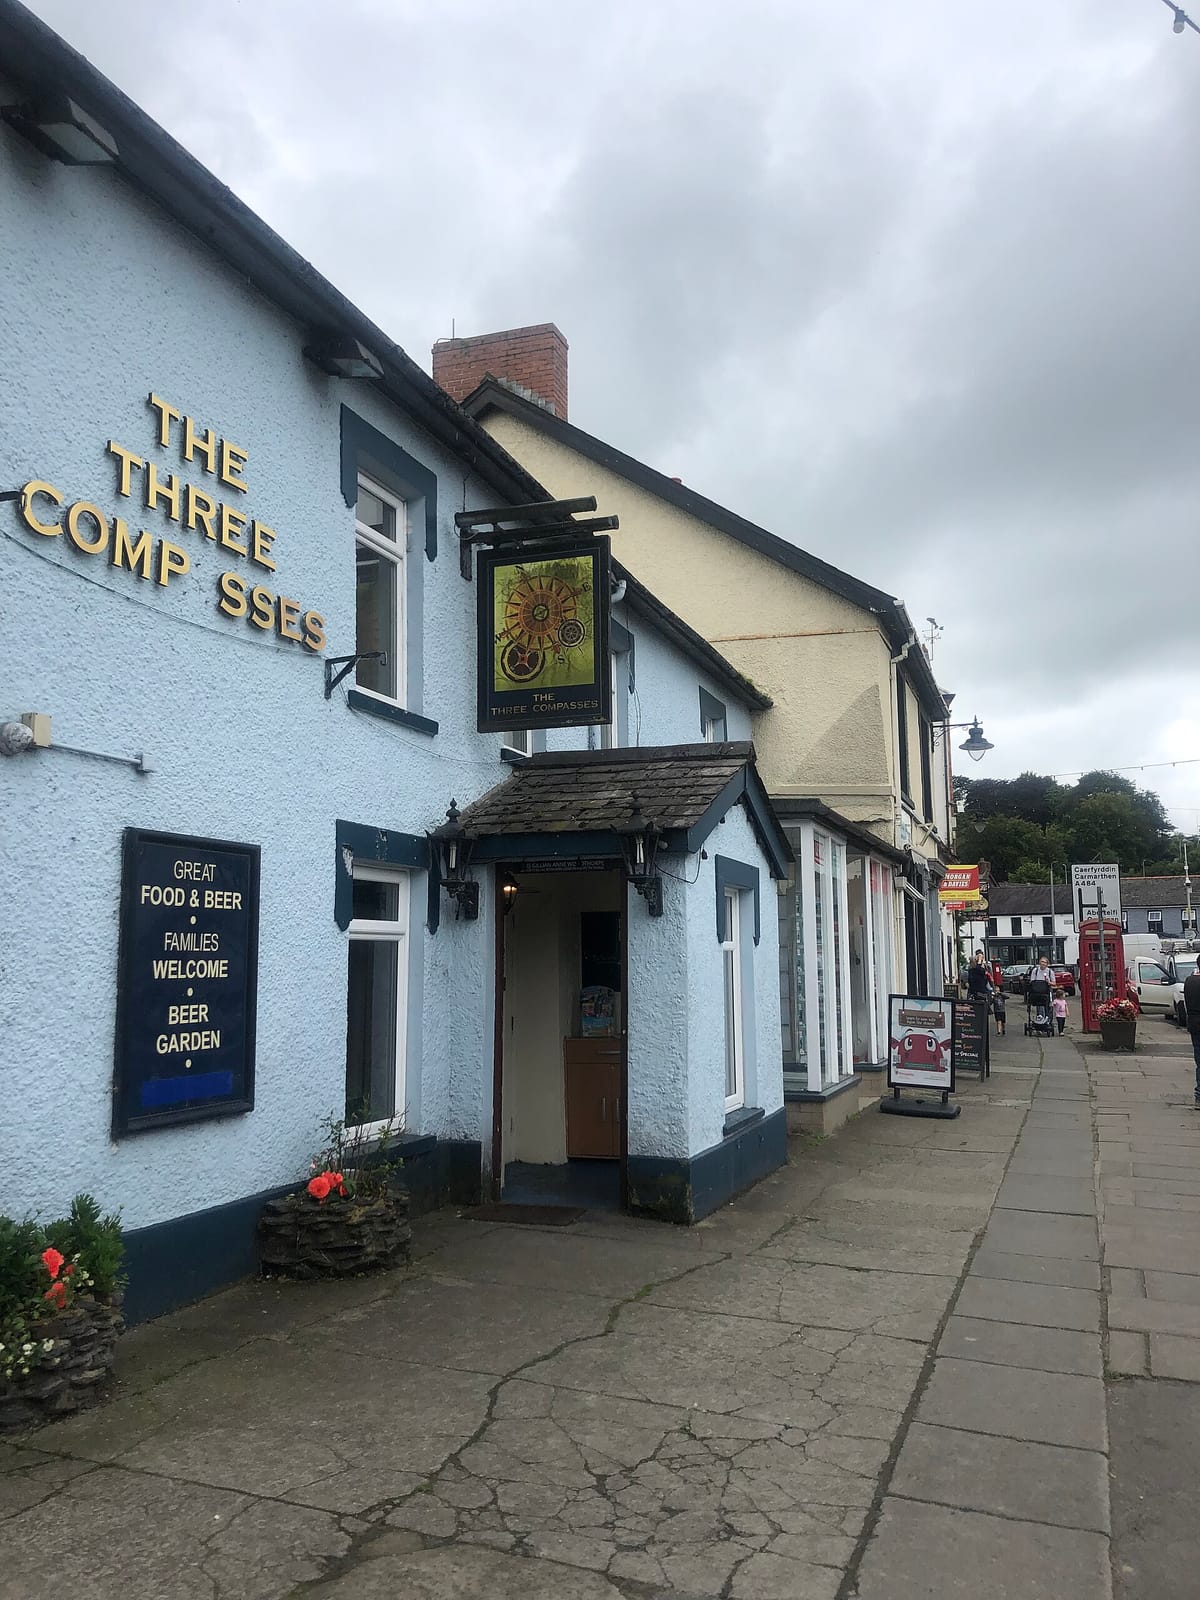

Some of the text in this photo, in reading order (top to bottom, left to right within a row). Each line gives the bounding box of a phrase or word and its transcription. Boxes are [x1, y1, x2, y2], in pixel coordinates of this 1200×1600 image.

[149, 392, 248, 494] THE
[107, 440, 277, 572] THREE
[491, 700, 598, 716] THREE COMPASSES
[533, 693, 555, 702] THE
[174, 860, 217, 882] GREAT
[141, 885, 242, 910] FOOD & BEER
[164, 932, 219, 952] FAMILIES
[153, 959, 229, 979] WELCOME
[168, 1004, 209, 1025] BEER
[156, 1030, 221, 1054] GARDEN
